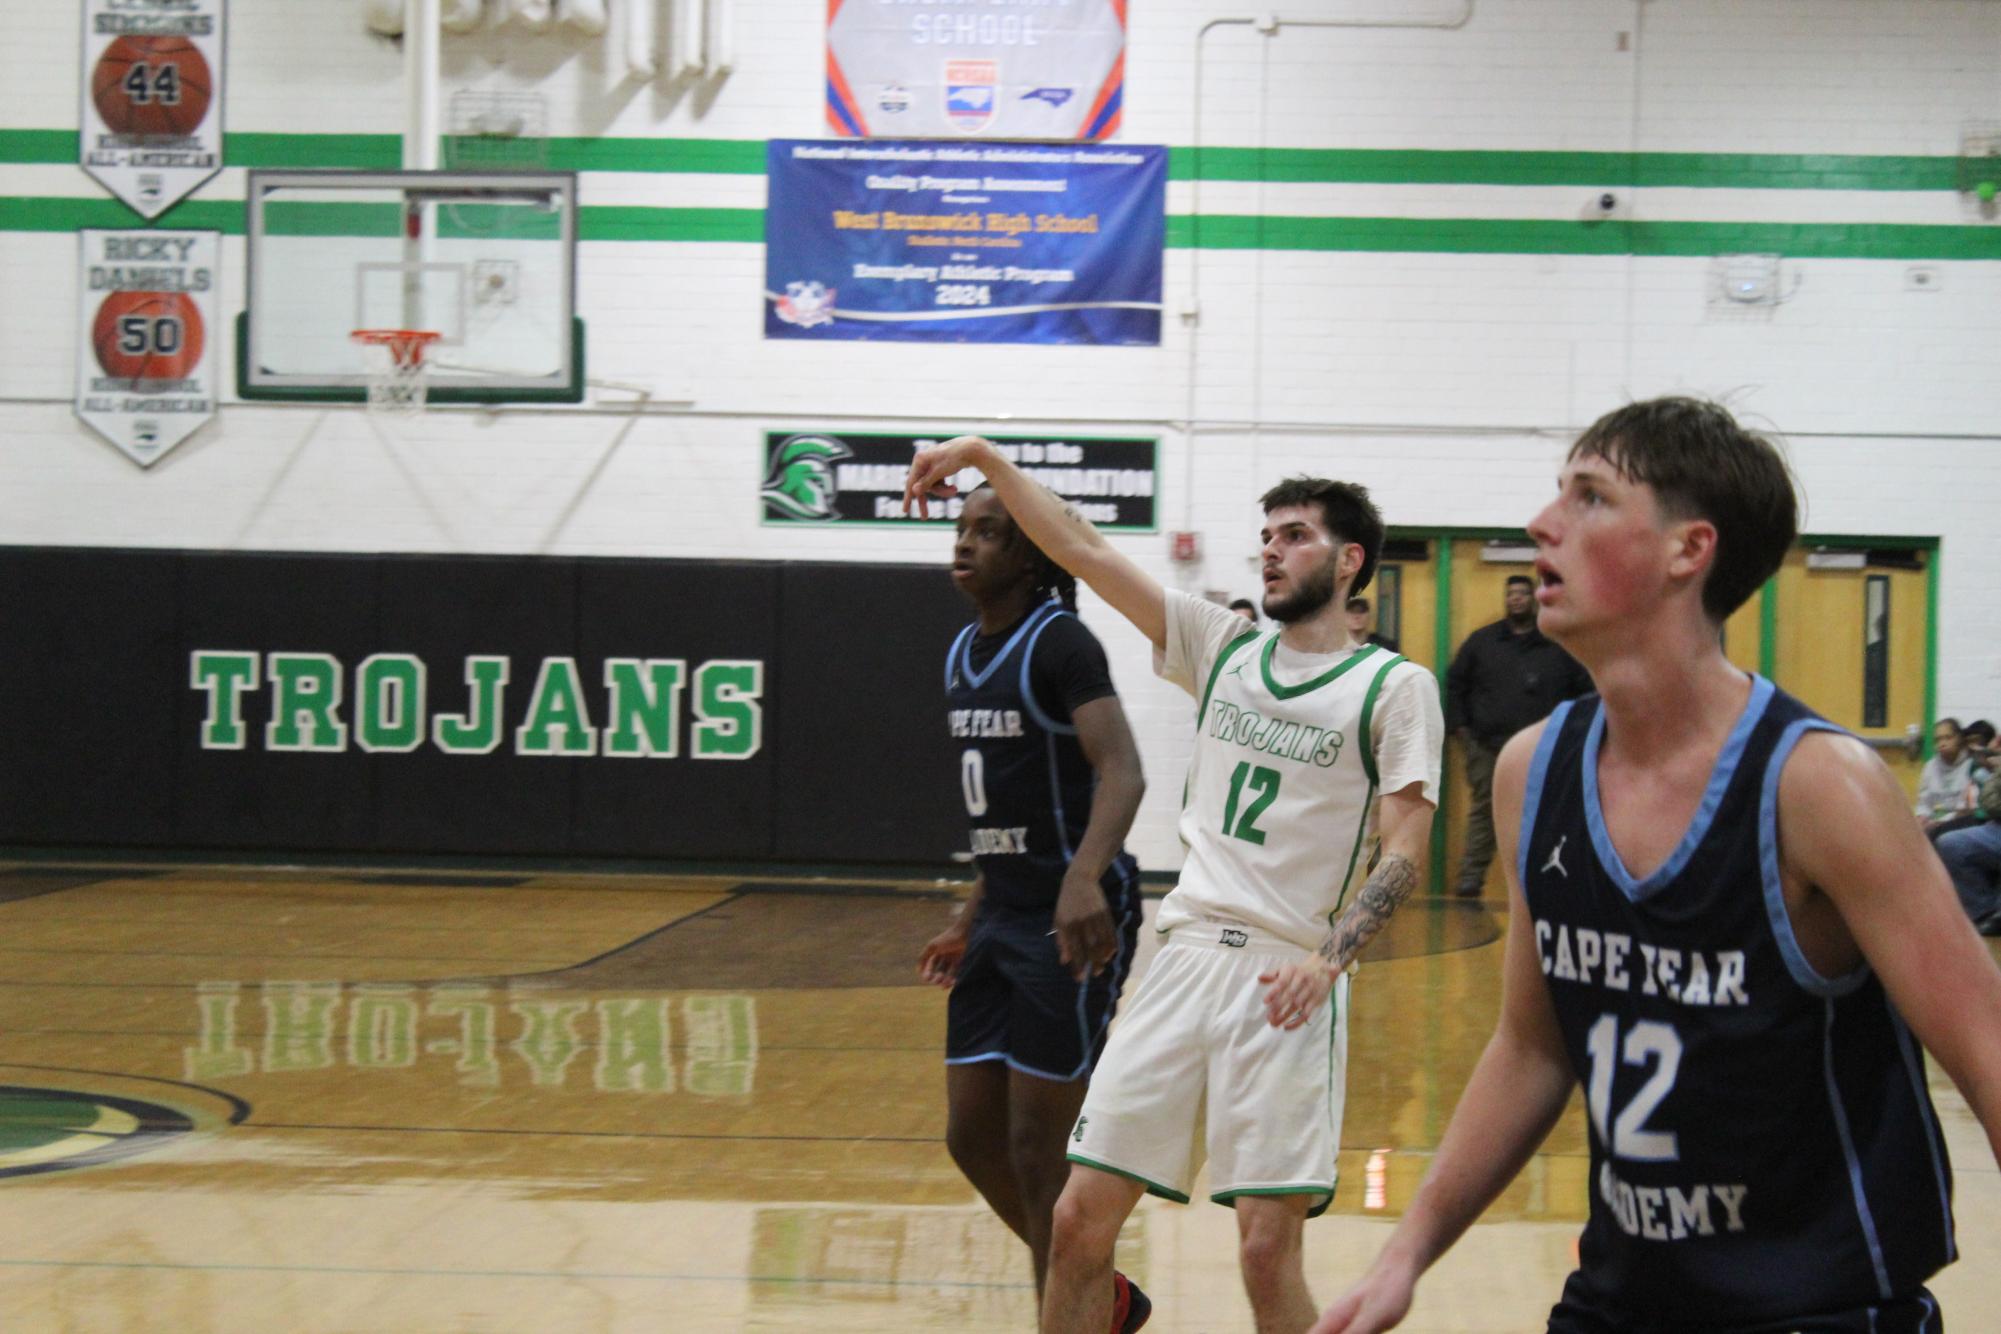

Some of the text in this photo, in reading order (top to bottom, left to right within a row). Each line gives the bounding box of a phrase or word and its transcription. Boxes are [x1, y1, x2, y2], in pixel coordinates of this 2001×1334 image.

[911, 14, 1039, 46] SCHOOL
[122, 61, 181, 105] 44
[832, 210, 1099, 237] West Brunswick High School
[104, 237, 196, 261] RICKY
[88, 266, 211, 292] DANIELS
[935, 284, 991, 305] 2024
[118, 315, 184, 356] 50
[1021, 443, 1044, 463] to
[1046, 442, 1083, 464] the
[190, 650, 763, 760] TROJANS
[1210, 699, 1345, 768] TROJANS
[961, 749, 988, 817] 0
[1221, 760, 1282, 847] 12
[1534, 919, 1631, 991] CAPE
[1586, 1013, 1684, 1162] 12
